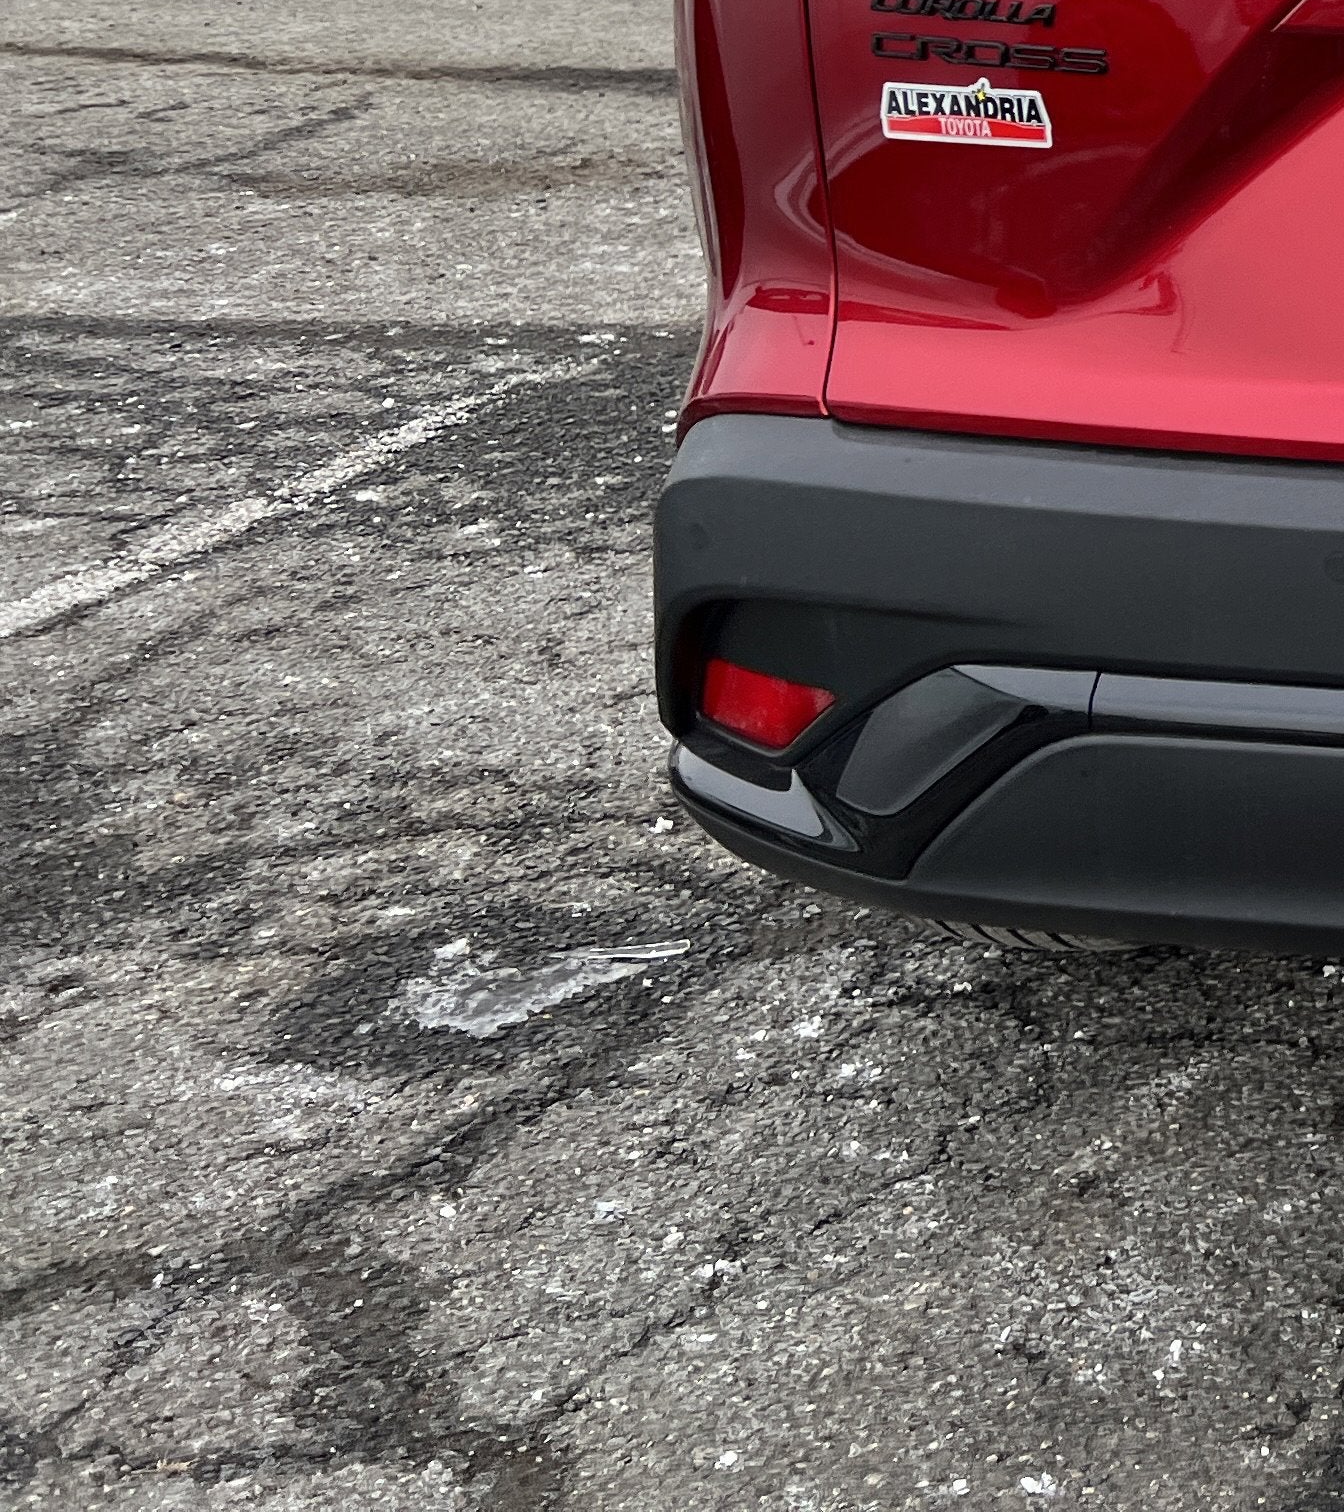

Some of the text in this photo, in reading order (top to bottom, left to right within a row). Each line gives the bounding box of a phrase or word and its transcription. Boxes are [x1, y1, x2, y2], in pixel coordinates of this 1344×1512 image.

[871, 32, 1109, 75] CROSS
[887, 90, 1044, 125] ALEXANDRIA
[938, 117, 992, 138] TOYOTA
